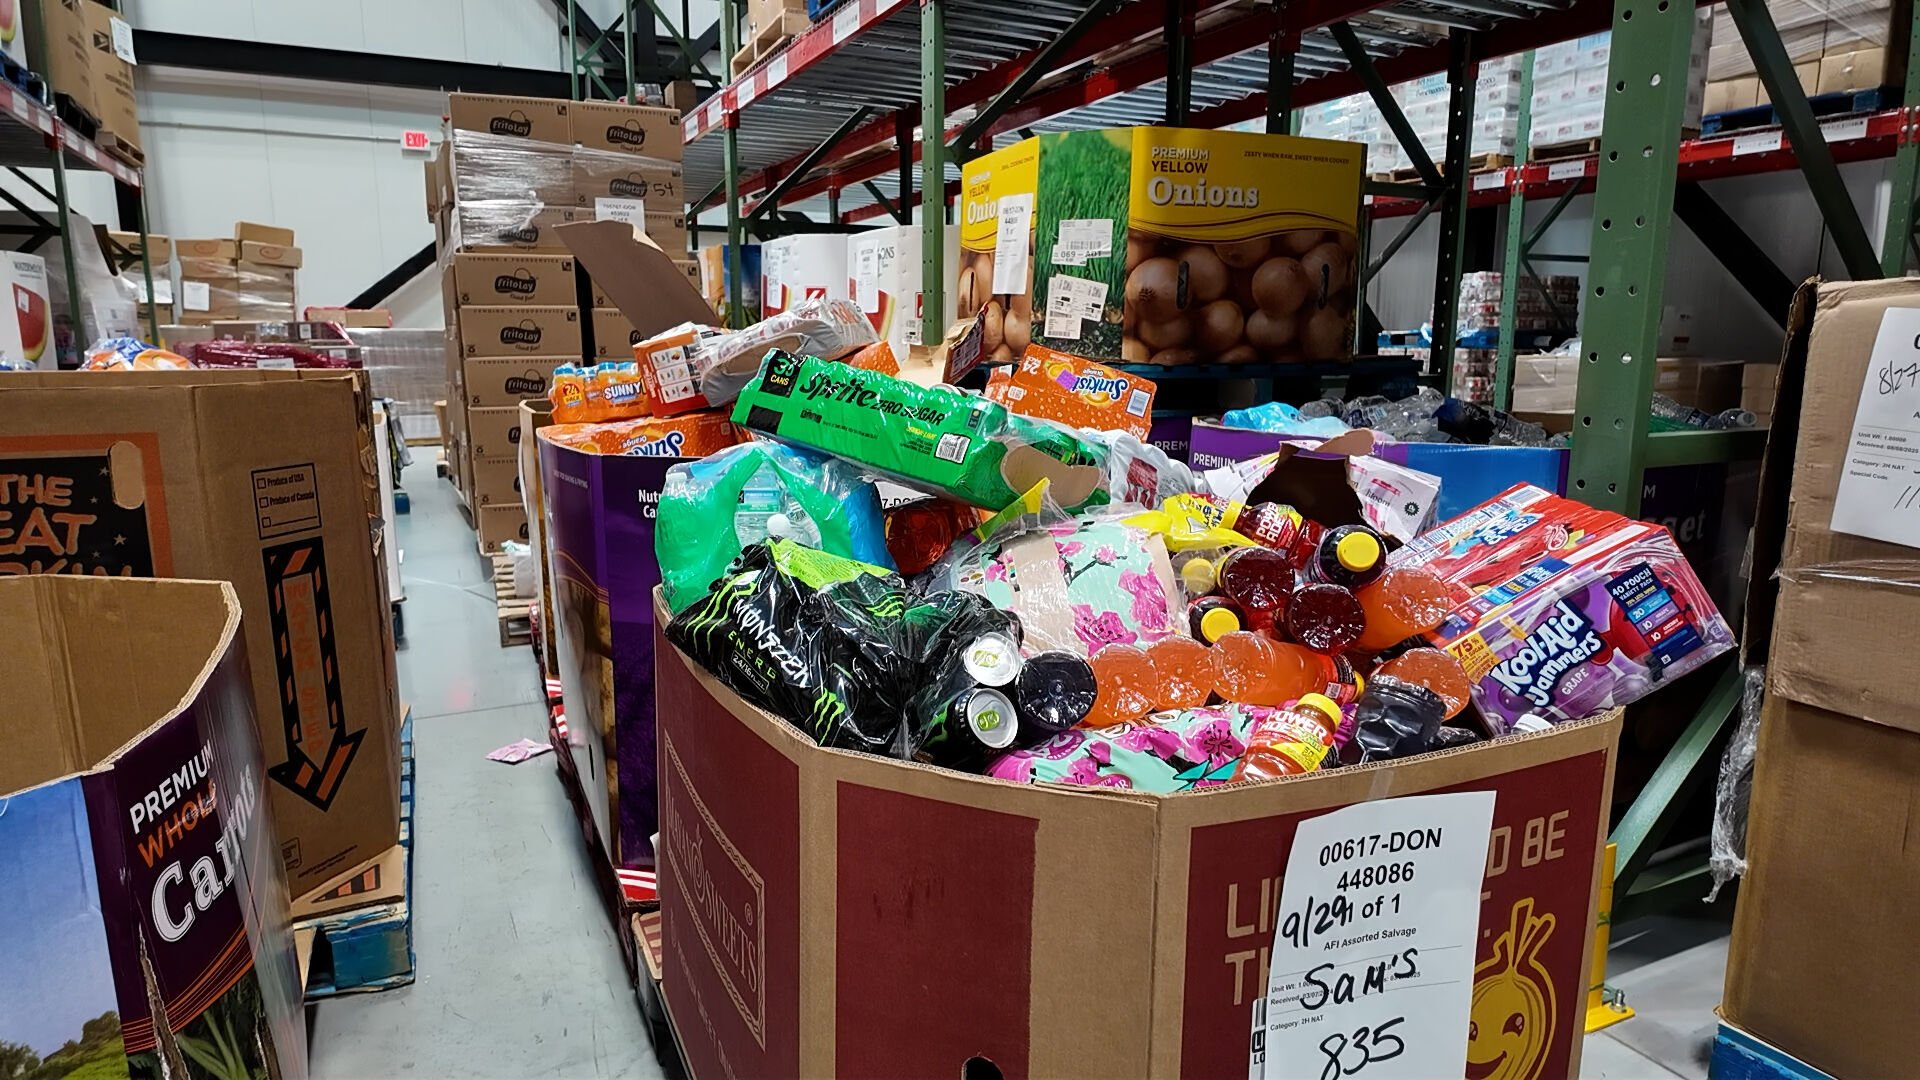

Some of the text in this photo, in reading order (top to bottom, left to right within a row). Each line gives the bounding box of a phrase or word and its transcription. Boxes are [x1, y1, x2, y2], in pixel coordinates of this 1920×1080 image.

[406, 131, 424, 148] EXIT
[1152, 146, 1209, 160] PREMIUM
[1152, 160, 1208, 174] YELLOW
[652, 182, 674, 196] 54
[968, 182, 990, 198] YELLOW
[1148, 176, 1260, 208] Onions
[1022, 360, 1041, 376] 24
[1082, 368, 1104, 377] Orange
[564, 382, 580, 396] 24
[604, 380, 641, 401] SUNNY
[770, 374, 790, 386] CANS
[799, 370, 878, 408] Sprite
[1072, 376, 1129, 400] Sunkist
[870, 400, 946, 426] ZERO SUGAR
[622, 436, 648, 449] Orange
[1194, 452, 1236, 468] PREMIUM
[1852, 458, 1880, 468] Category:
[267, 476, 288, 487] Produce
[294, 472, 304, 482] USA
[1850, 470, 1870, 478] Special
[0, 474, 74, 507] THE
[270, 496, 290, 506] Produce
[296, 491, 314, 502] Canada
[1612, 568, 1652, 597] 40 POUCH
[1618, 578, 1654, 600] VARIETY PACK
[1632, 608, 1645, 620] 20
[1642, 620, 1652, 631] 10
[732, 598, 809, 688] MONSTER
[1650, 632, 1662, 642] 10
[728, 630, 777, 680] ENERG
[1526, 632, 1602, 707] Jammers
[1561, 668, 1590, 696] GRAPE
[1268, 710, 1328, 741] POWER
[130, 739, 215, 834] PREMIUM
[1319, 828, 1442, 866] 00617-DON
[1521, 810, 1570, 868] BE
[151, 764, 256, 942] Carrots
[1336, 862, 1414, 892] 448086
[1362, 896, 1384, 919] of
[1392, 893, 1400, 914] 1
[704, 868, 757, 993] SWEETS
[1282, 894, 1348, 948] 9/29
[1324, 926, 1416, 951] AFI Assorted Salvage
[1271, 985, 1285, 994] Unit
[1310, 1014, 1324, 1023] NAT
[1319, 1016, 1405, 1080] 835
